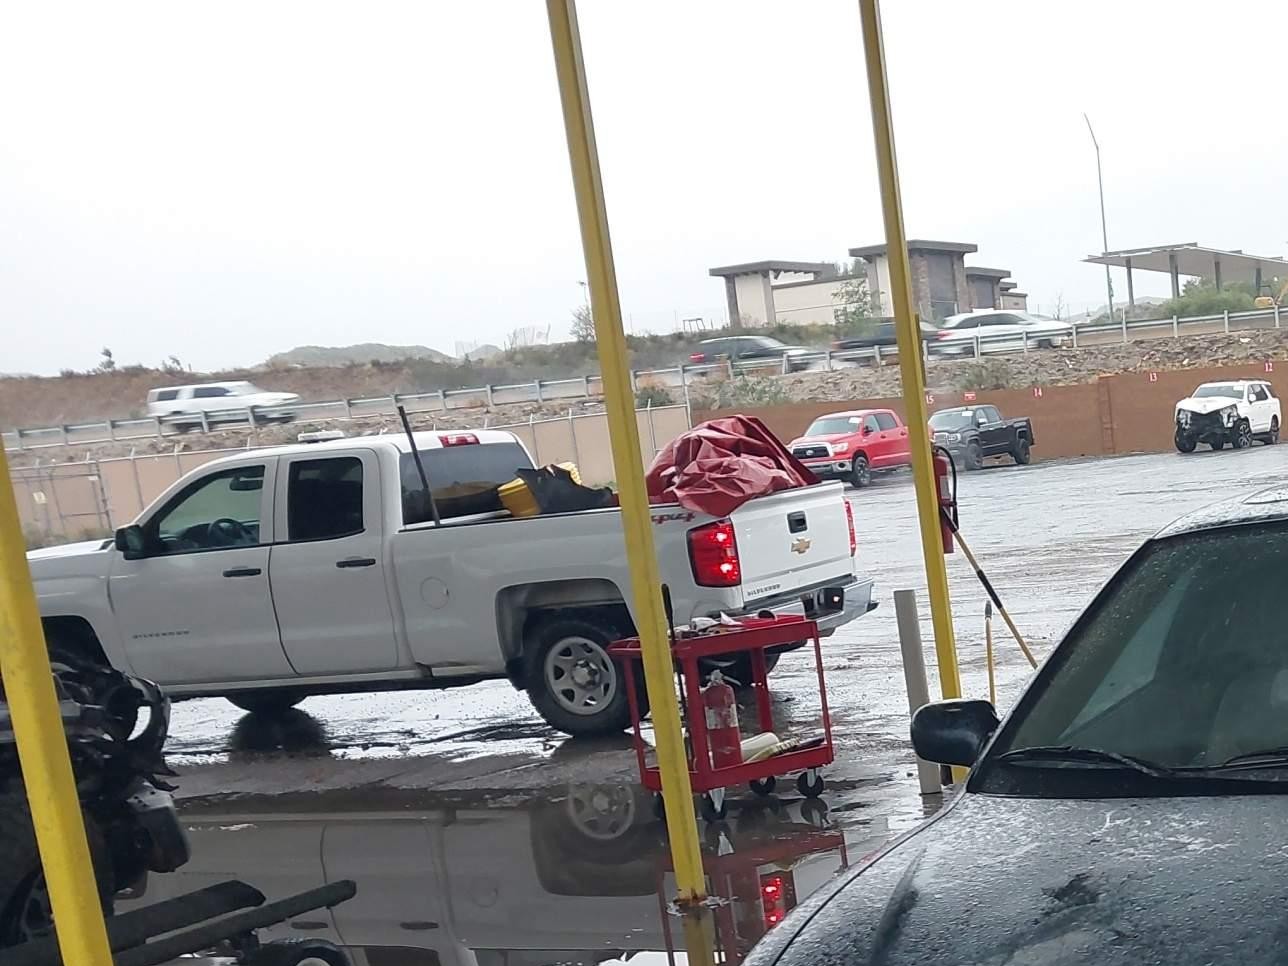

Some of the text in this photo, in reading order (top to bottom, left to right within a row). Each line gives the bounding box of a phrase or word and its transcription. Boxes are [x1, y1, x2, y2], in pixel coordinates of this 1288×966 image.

[1265, 362, 1274, 372] 12
[1149, 372, 1159, 382] 13
[1033, 387, 1043, 397] 14
